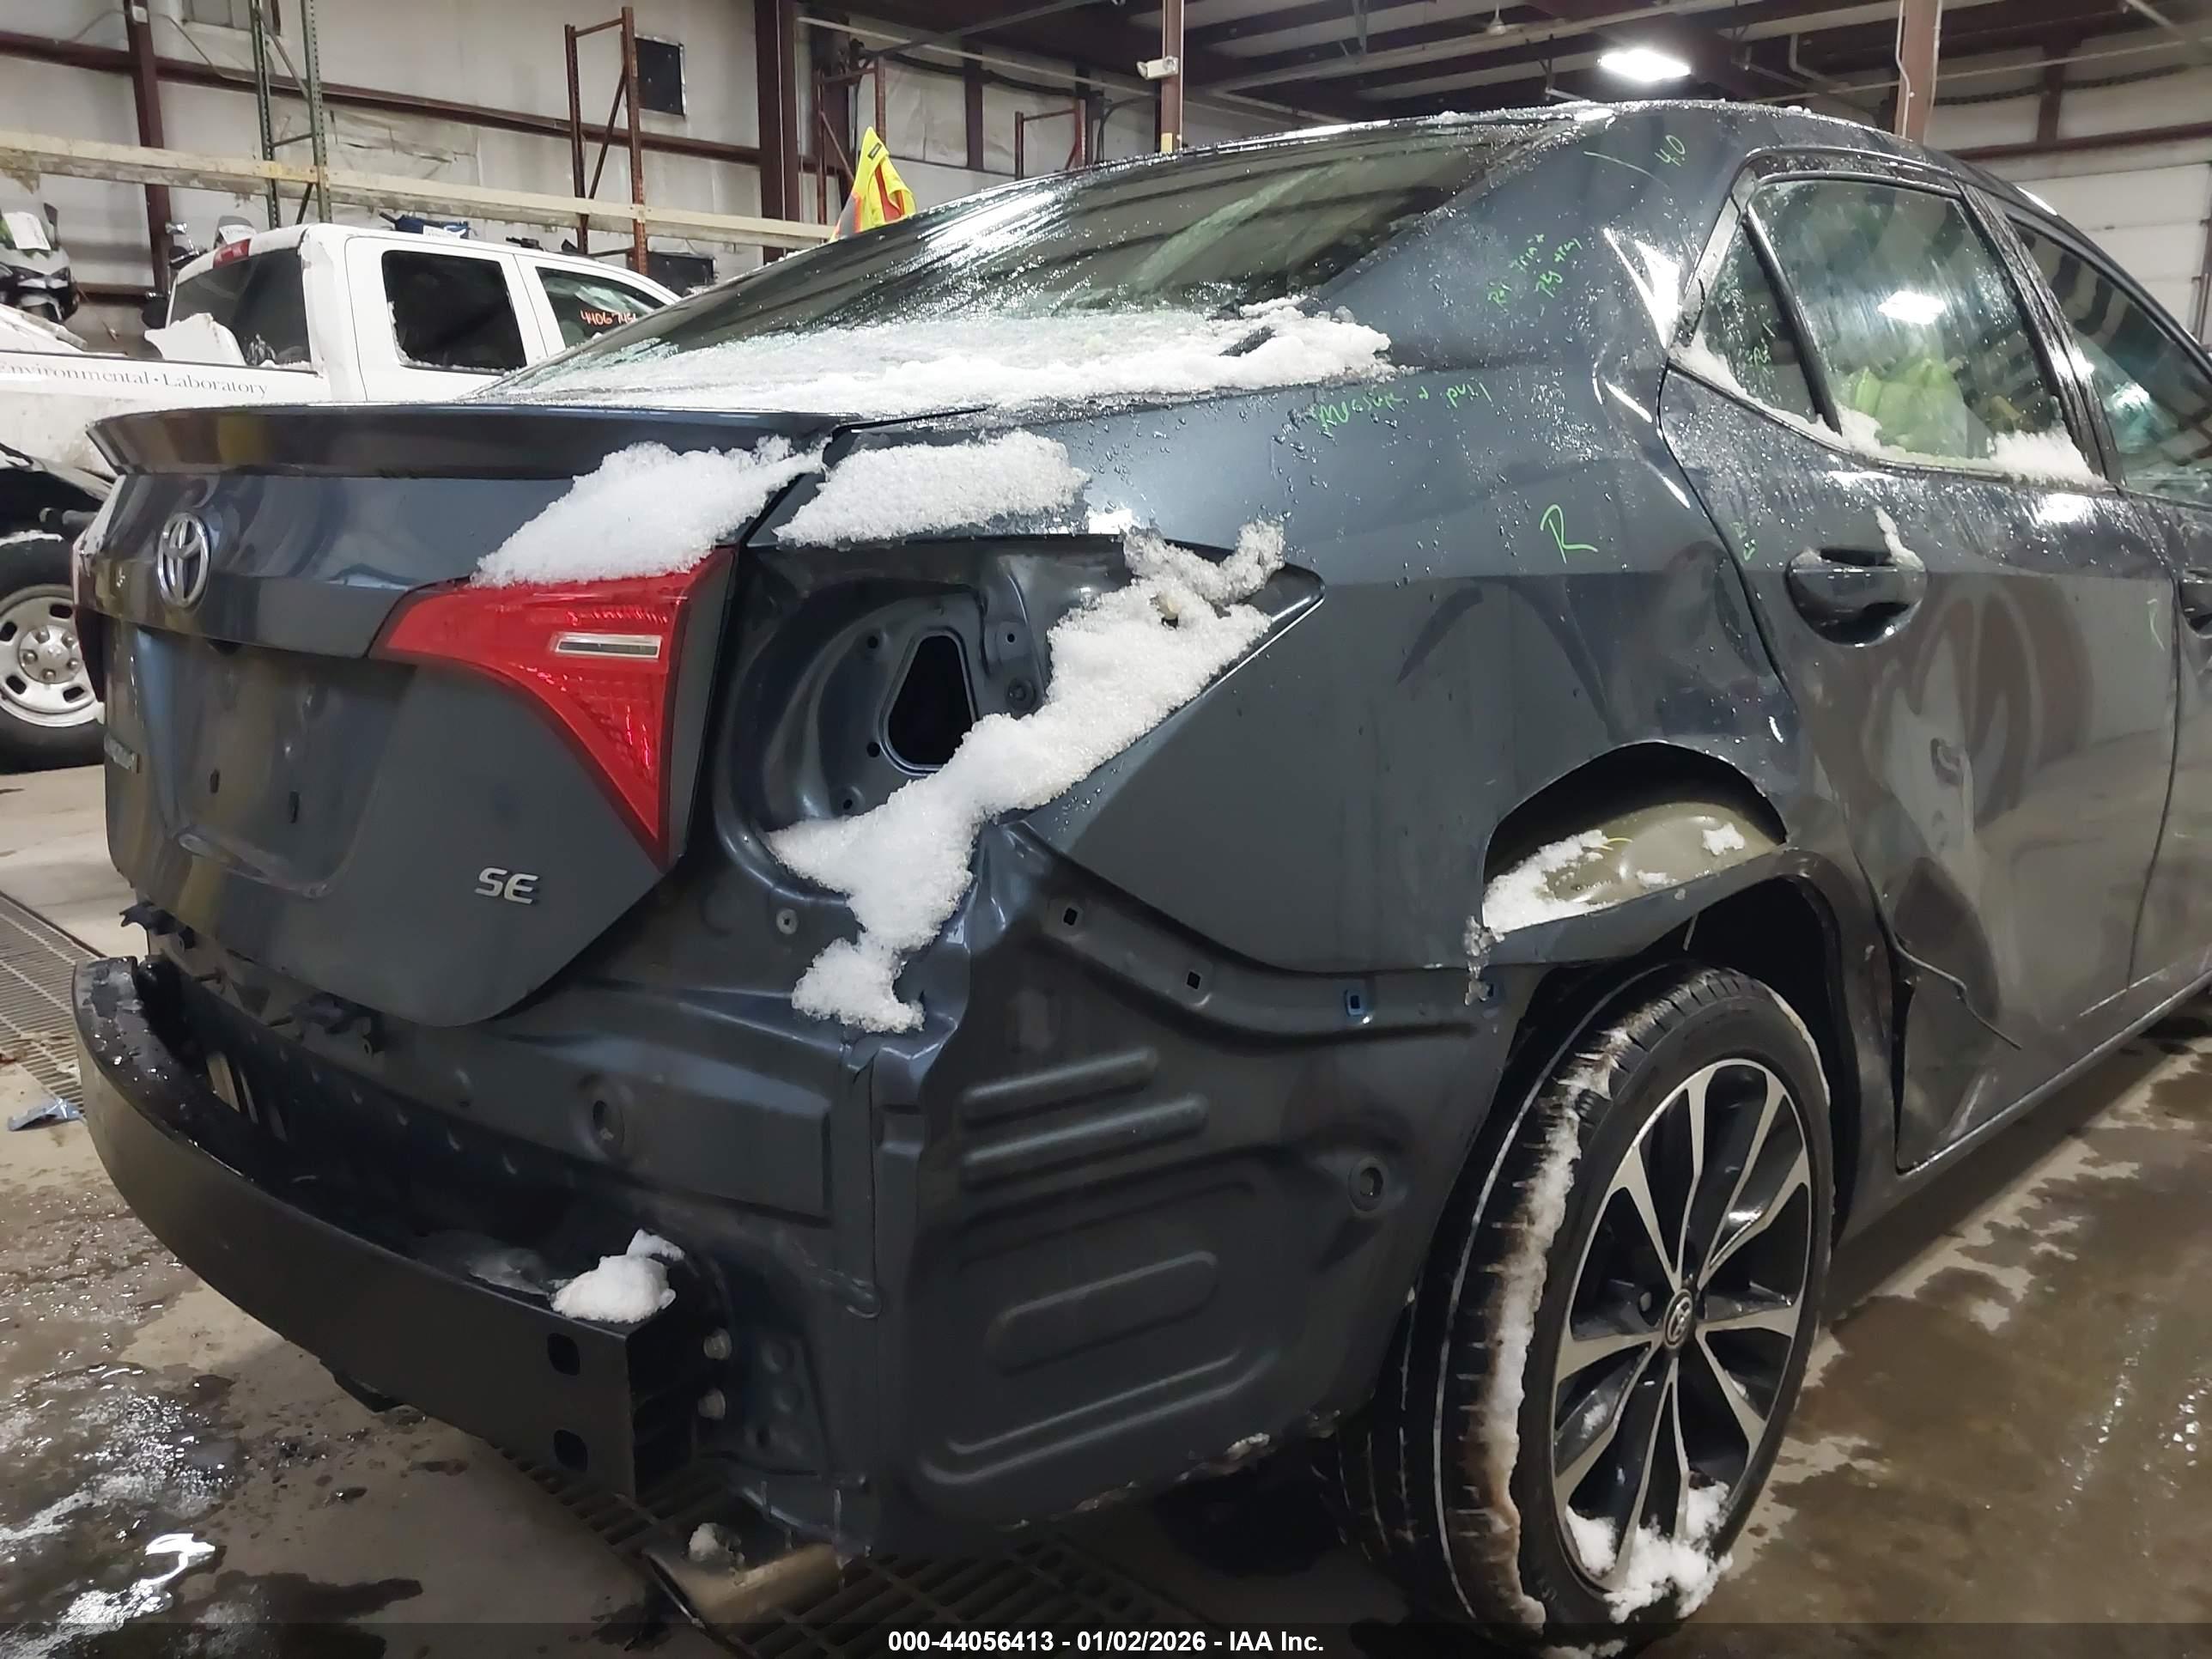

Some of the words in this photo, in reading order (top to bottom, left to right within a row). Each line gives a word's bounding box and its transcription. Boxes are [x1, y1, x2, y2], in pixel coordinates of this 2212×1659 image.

[162, 373, 268, 399] Laboratory
[1539, 503, 1599, 564] R
[473, 866, 539, 905] SE
